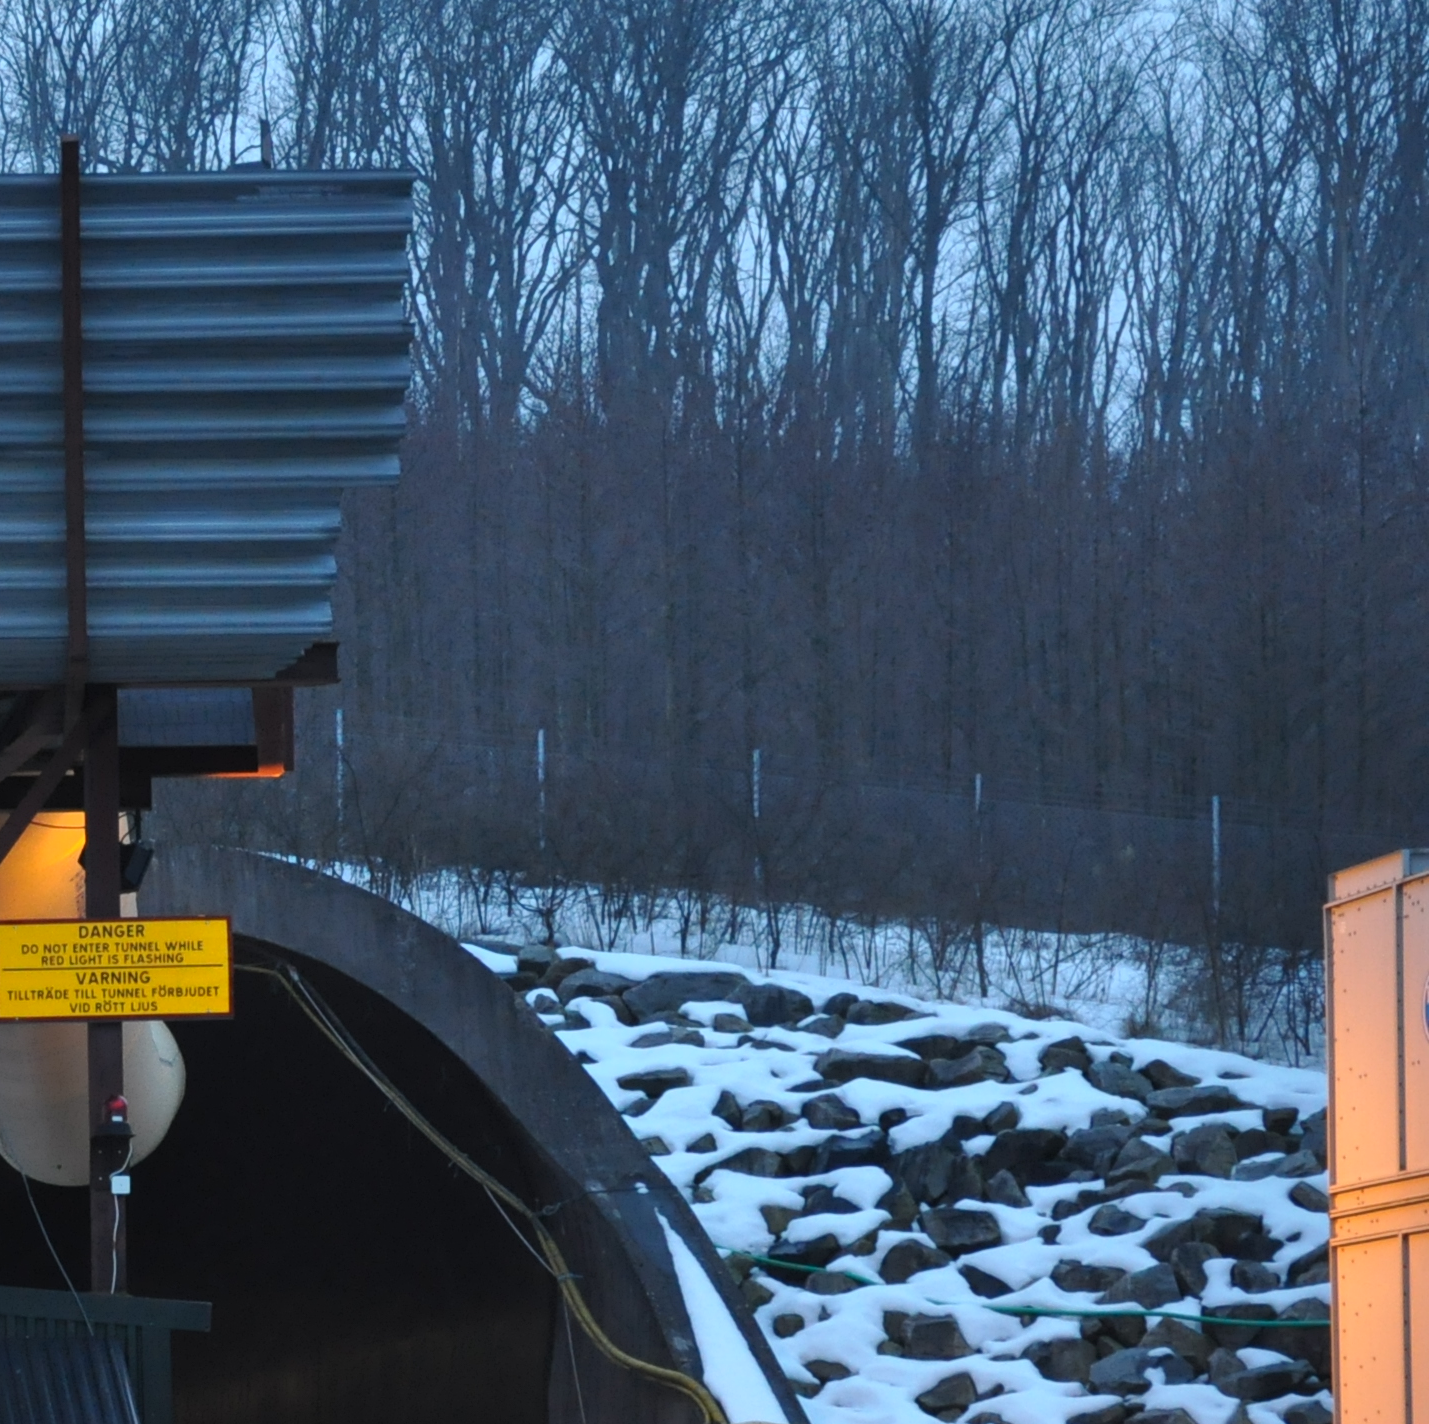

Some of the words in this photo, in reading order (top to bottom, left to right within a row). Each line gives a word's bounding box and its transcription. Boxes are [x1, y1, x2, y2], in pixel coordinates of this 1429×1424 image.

[79, 924, 145, 938] DANGER
[21, 944, 39, 955] DO
[43, 944, 68, 954] NOT
[73, 943, 110, 953] ENTER
[115, 942, 160, 952] TUNNEL
[165, 941, 203, 952] WHILE
[41, 956, 65, 966] RED
[69, 955, 103, 966] LIGHT
[108, 954, 119, 965] IS
[124, 953, 184, 965] FLASHING
[76, 971, 151, 985] VARNING
[7, 987, 69, 1001] TILLTRÄDE
[74, 989, 97, 999] TILL
[101, 988, 147, 999] TUNNEL
[152, 985, 219, 998] FÖRBJUDET
[69, 1003, 91, 1014] VID
[95, 1000, 126, 1013] RÖTT
[131, 1002, 158, 1012] LJUS
